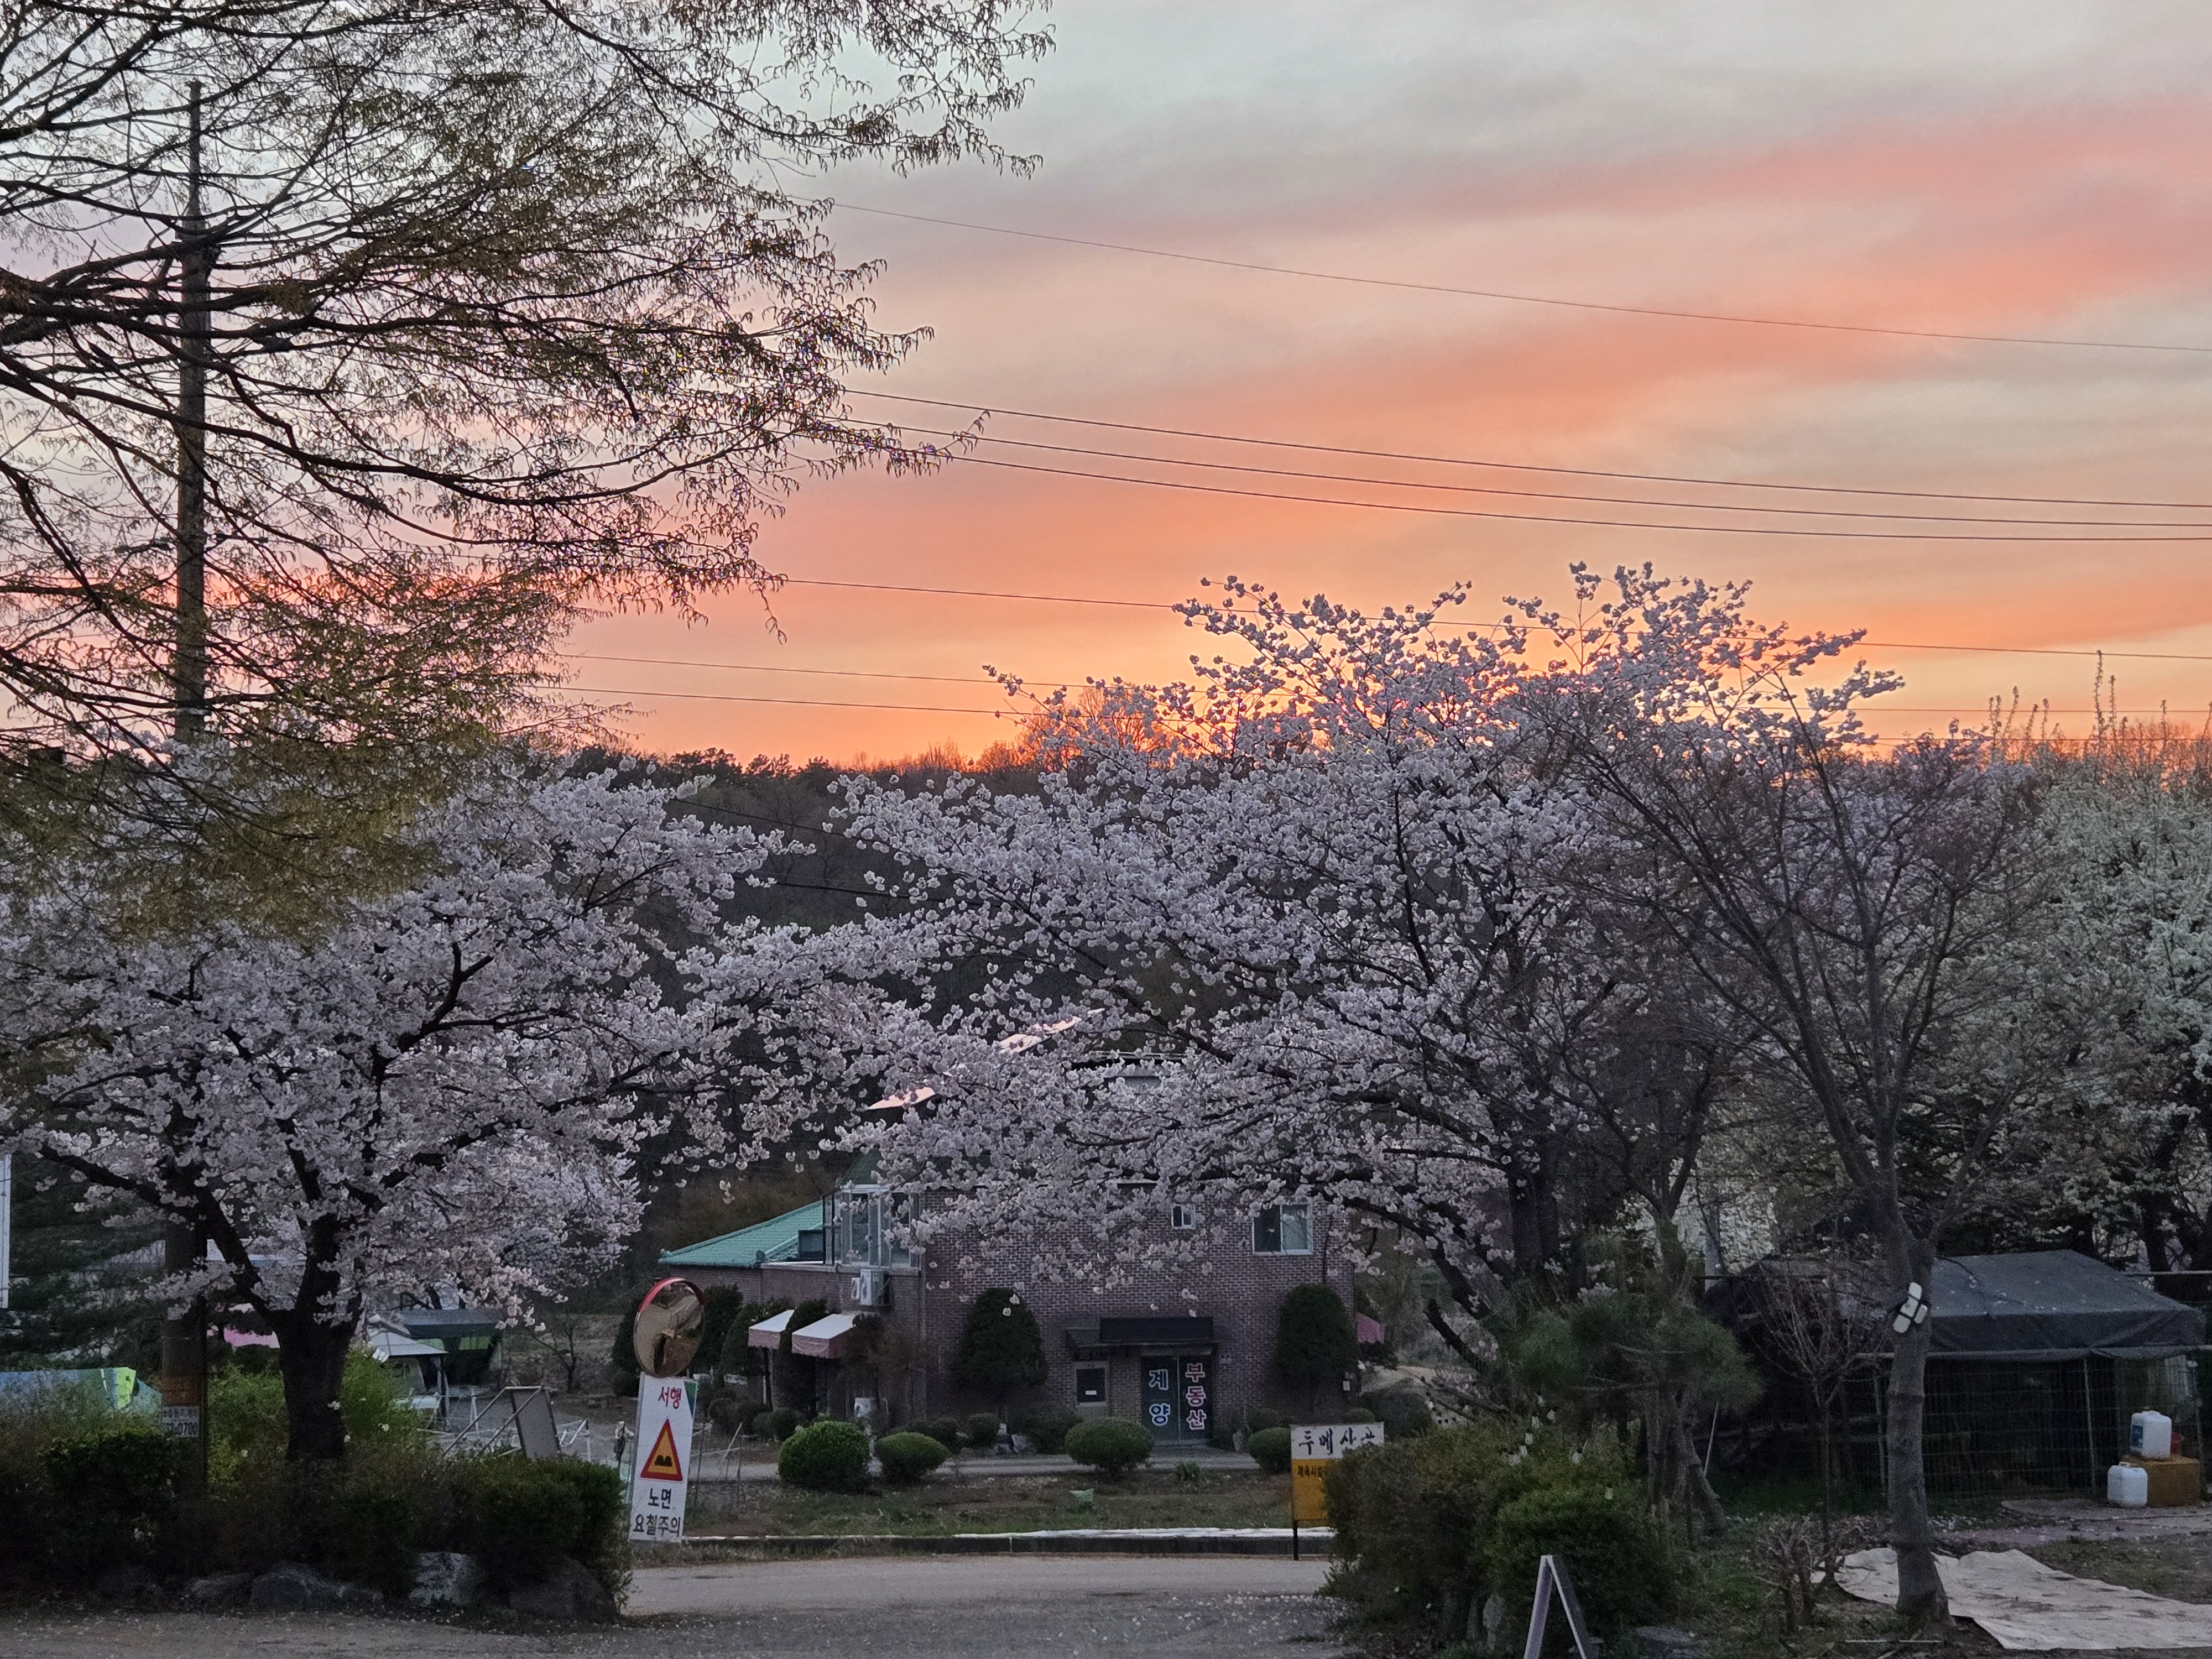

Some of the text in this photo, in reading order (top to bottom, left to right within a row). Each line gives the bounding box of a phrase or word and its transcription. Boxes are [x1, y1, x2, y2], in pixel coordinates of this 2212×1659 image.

[658, 1386, 682, 1409] 서행
[1149, 1369, 1171, 1426] 계양
[1185, 1363, 1207, 1431] 부동산
[648, 1488, 672, 1510] 노면
[633, 1514, 681, 1538] 요철주의
